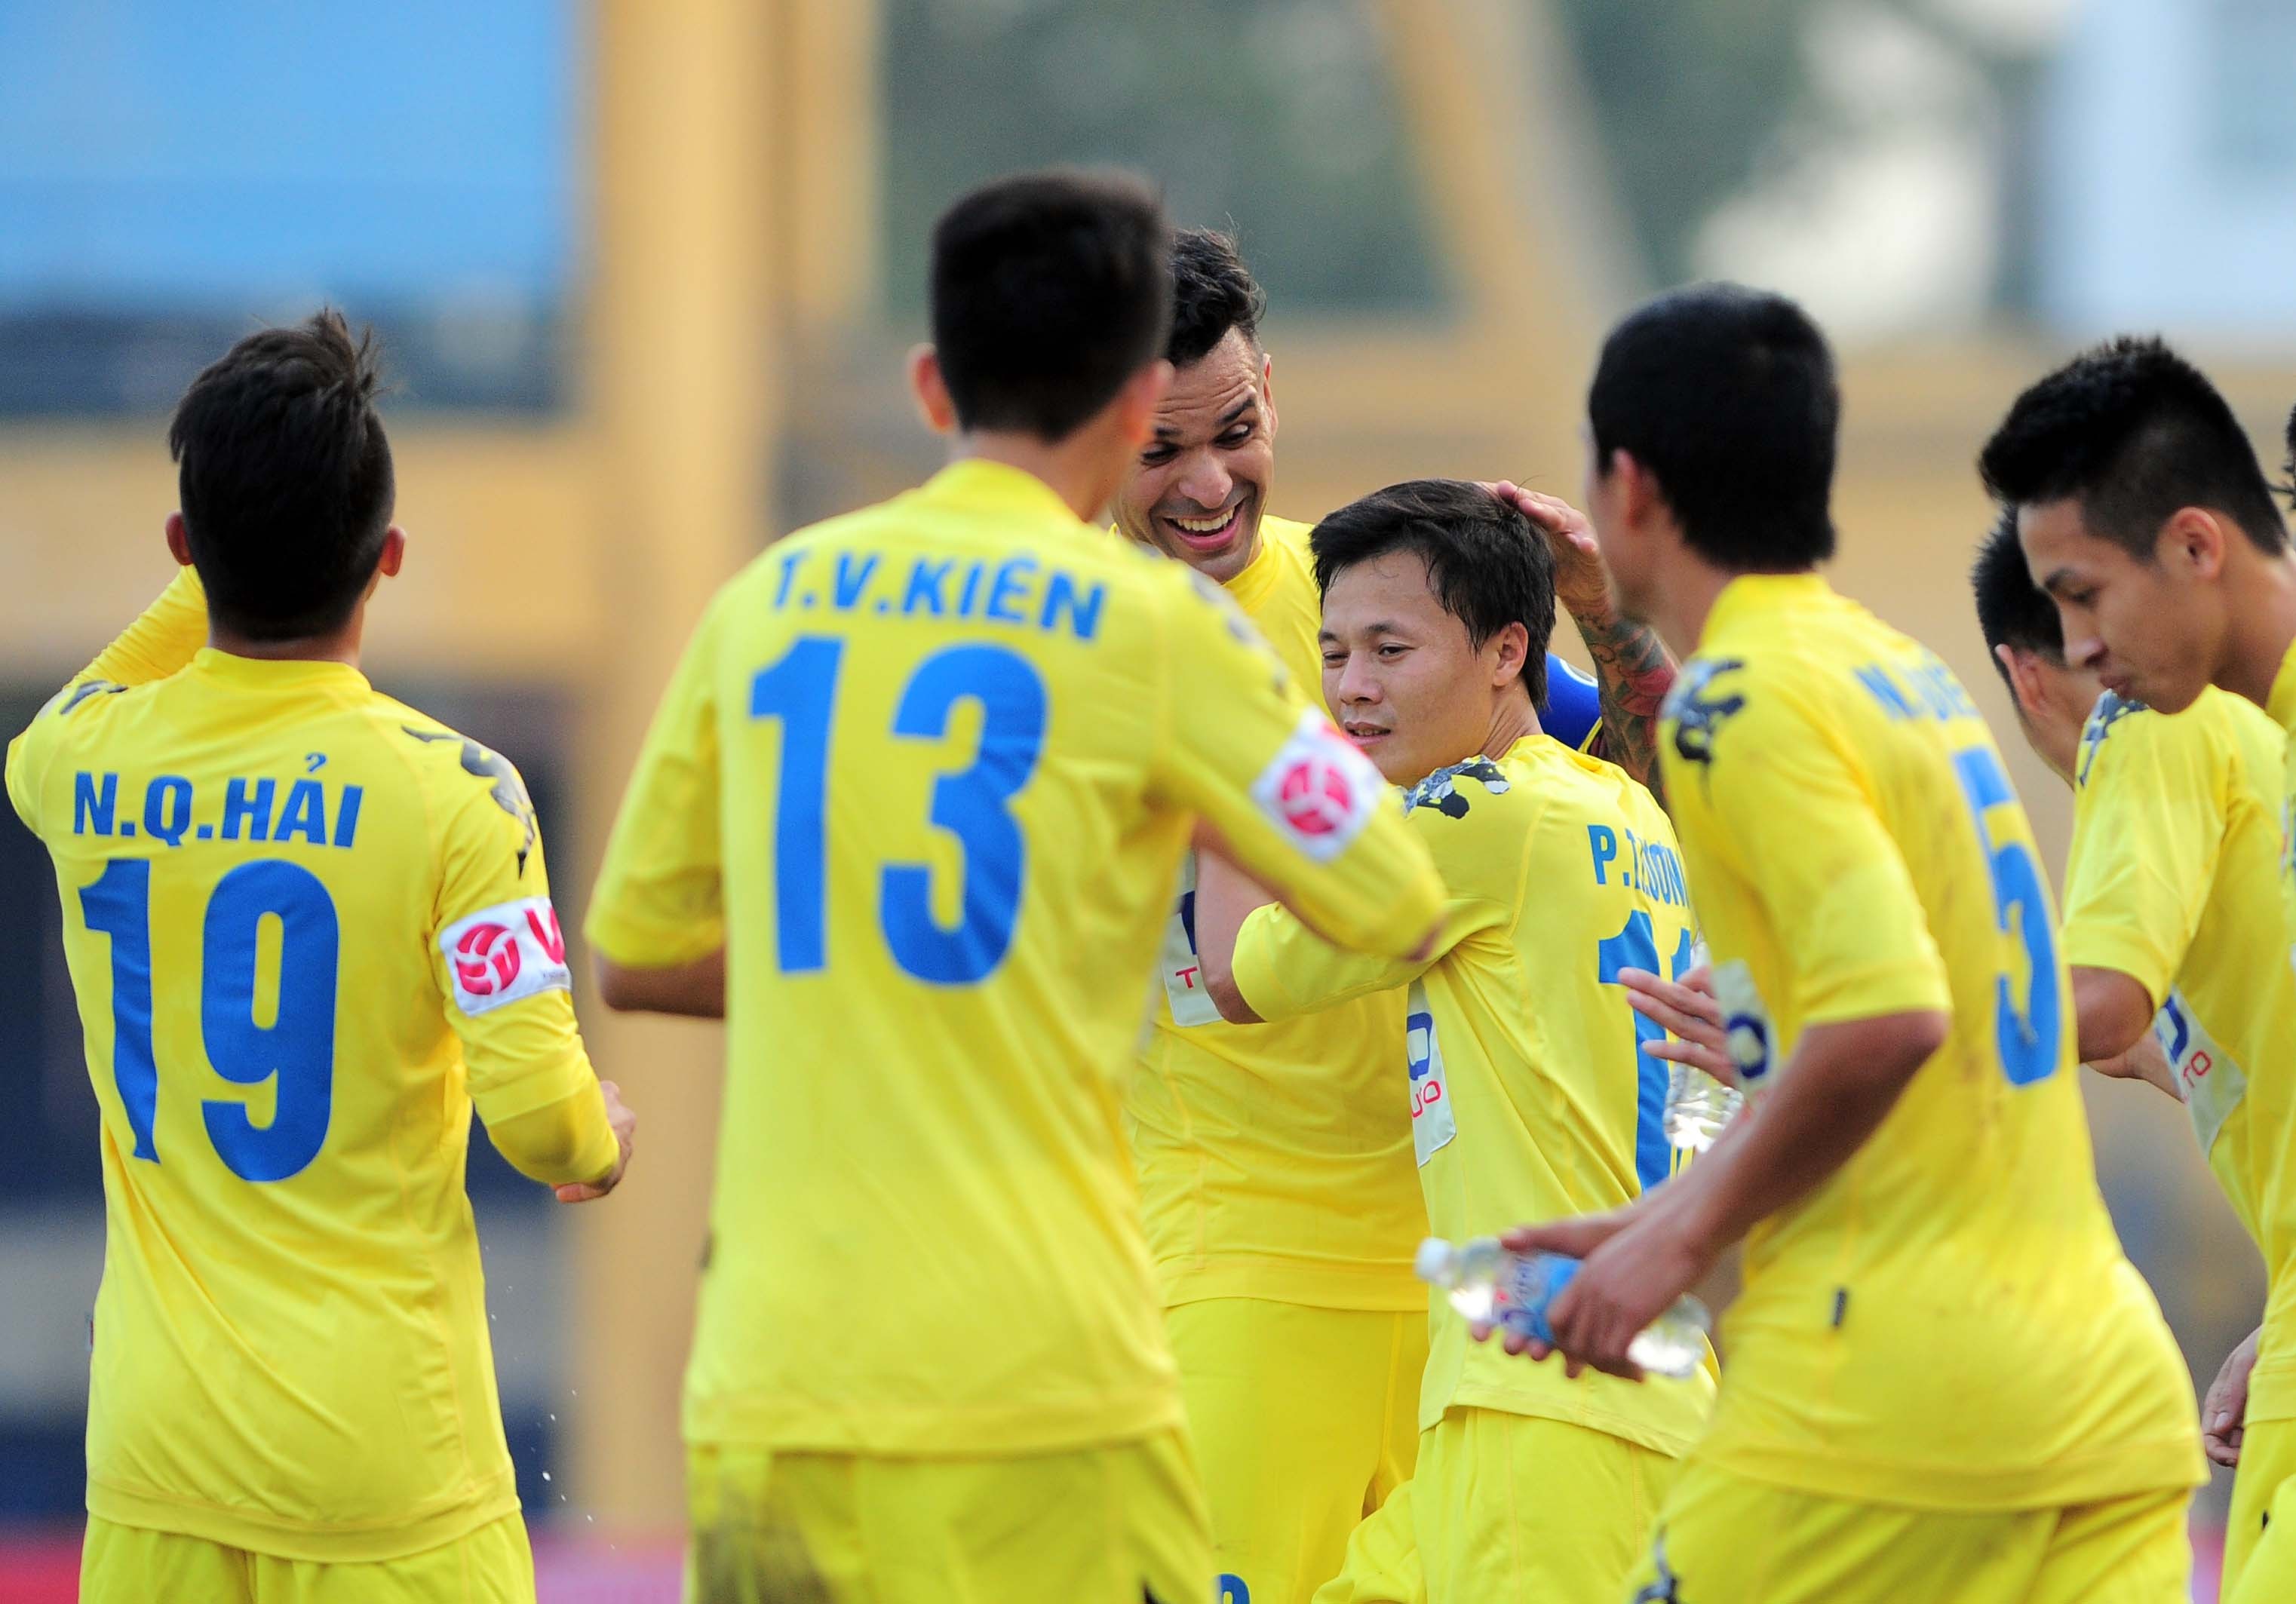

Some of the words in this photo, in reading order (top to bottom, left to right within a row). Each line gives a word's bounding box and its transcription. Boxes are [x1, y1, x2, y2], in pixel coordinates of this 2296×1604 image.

[73, 752, 364, 848] N.Q.HẢI
[747, 633, 1050, 987] 13
[1953, 746, 2062, 1087] 5
[78, 857, 340, 1183] 19
